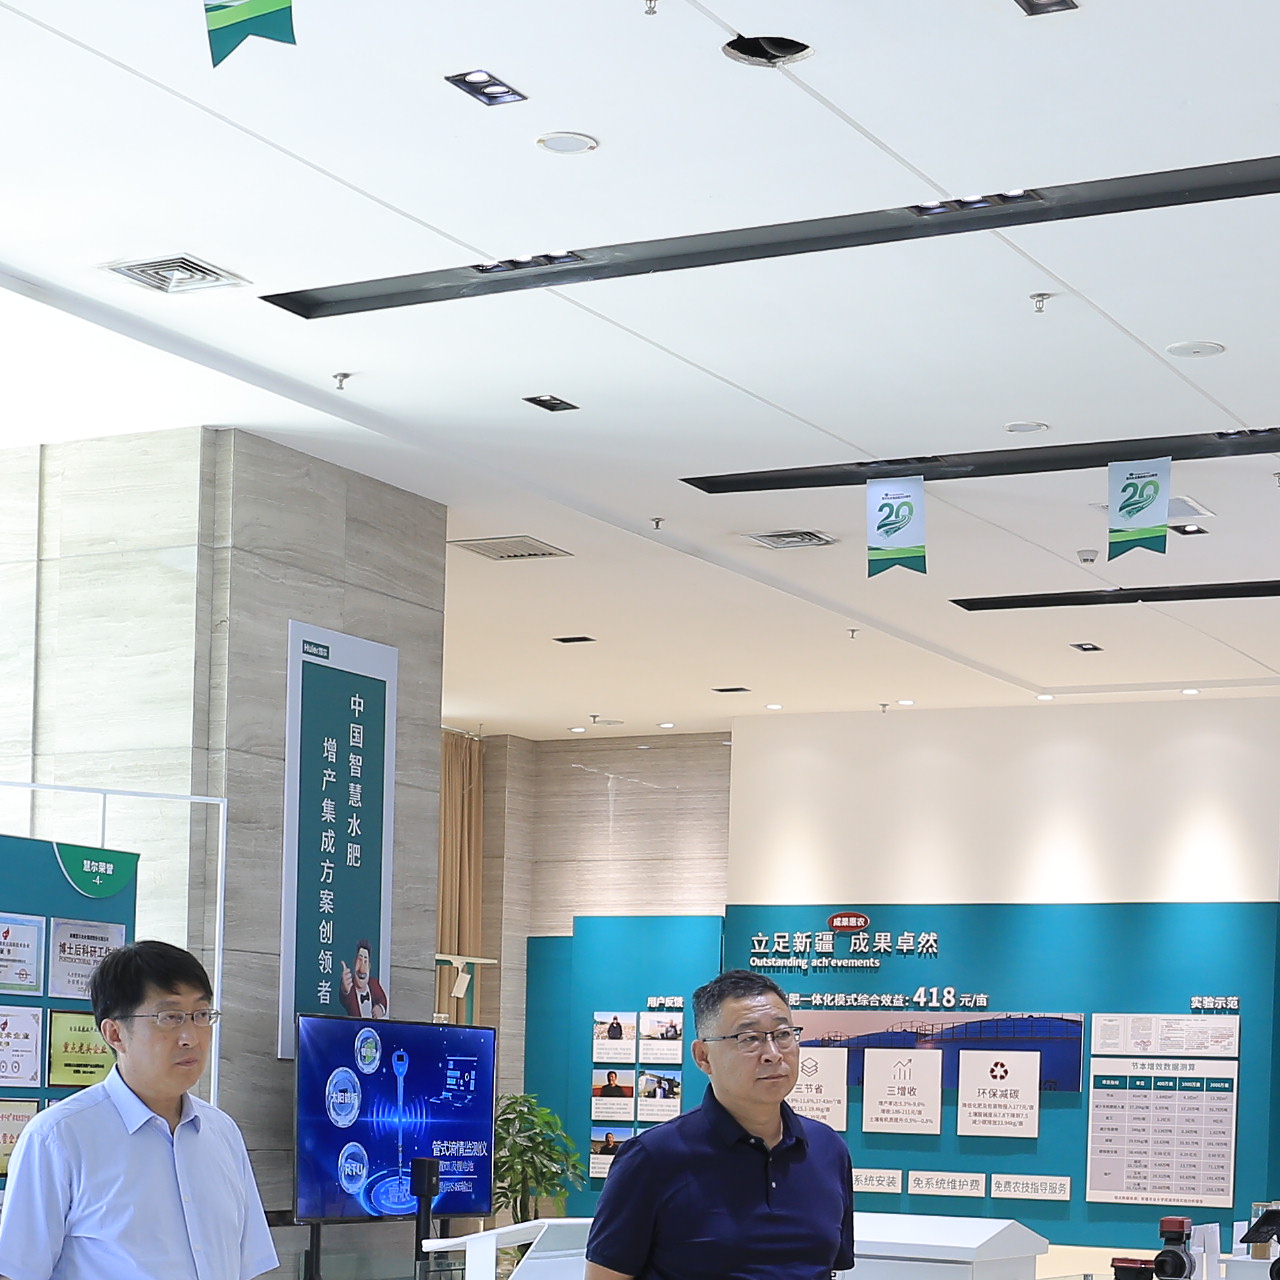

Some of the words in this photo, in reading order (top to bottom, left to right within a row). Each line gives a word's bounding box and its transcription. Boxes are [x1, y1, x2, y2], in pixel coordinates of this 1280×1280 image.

[346, 693, 364, 868] 中国智慧水肥
[82, 859, 114, 875] 慧尔荣誉
[317, 737, 338, 1005] 增产集成方案创领者
[832, 917, 865, 927] 成果惠农
[751, 932, 834, 953] 立足新疆
[849, 932, 939, 953] 成果卓然
[749, 957, 808, 969] Outstanding
[811, 957, 880, 968] achevements
[647, 996, 683, 1008] 用户反馈
[785, 993, 910, 1007] 肥一体化模式综合效益：
[913, 987, 955, 1007] 418
[959, 993, 987, 1008] 元/亩
[1190, 996, 1239, 1009] 实验示范
[1131, 1062, 1196, 1072] 节本增效数据测算
[794, 1083, 824, 1094] 三节省
[887, 1086, 918, 1097] 三增收
[977, 1088, 1020, 1099] 环保减碳
[344, 1164, 365, 1177] RTU
[854, 1175, 897, 1187] 系统安装
[912, 1177, 980, 1191] 免系统维护费
[994, 1181, 1067, 1195] 免费农技指导服务
